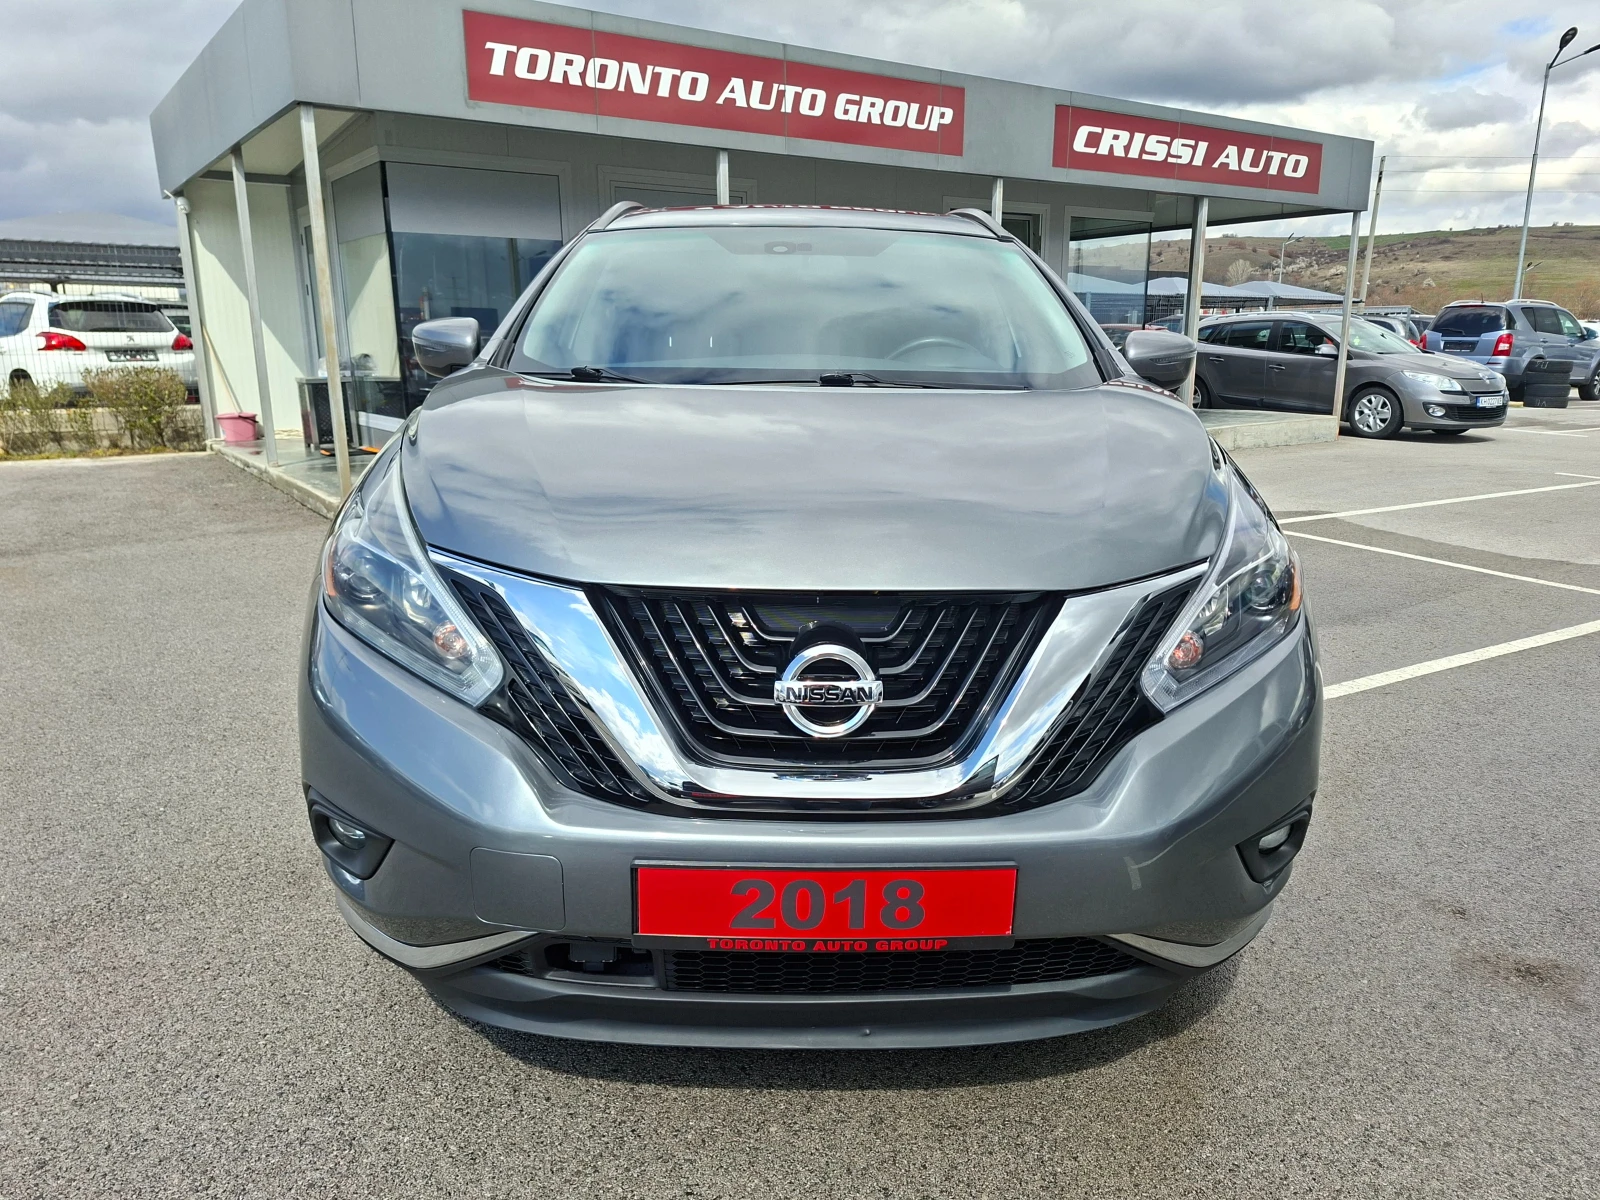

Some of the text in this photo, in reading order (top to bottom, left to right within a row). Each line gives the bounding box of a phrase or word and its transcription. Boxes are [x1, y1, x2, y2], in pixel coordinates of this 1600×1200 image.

[484, 41, 954, 132] TORONTO AUTO GROUP
[1072, 125, 1309, 178] CRISSI AUTO
[785, 685, 873, 703] NISSAN
[728, 878, 926, 930] 2018
[706, 938, 949, 952] TORONTO AUTO GROUP
